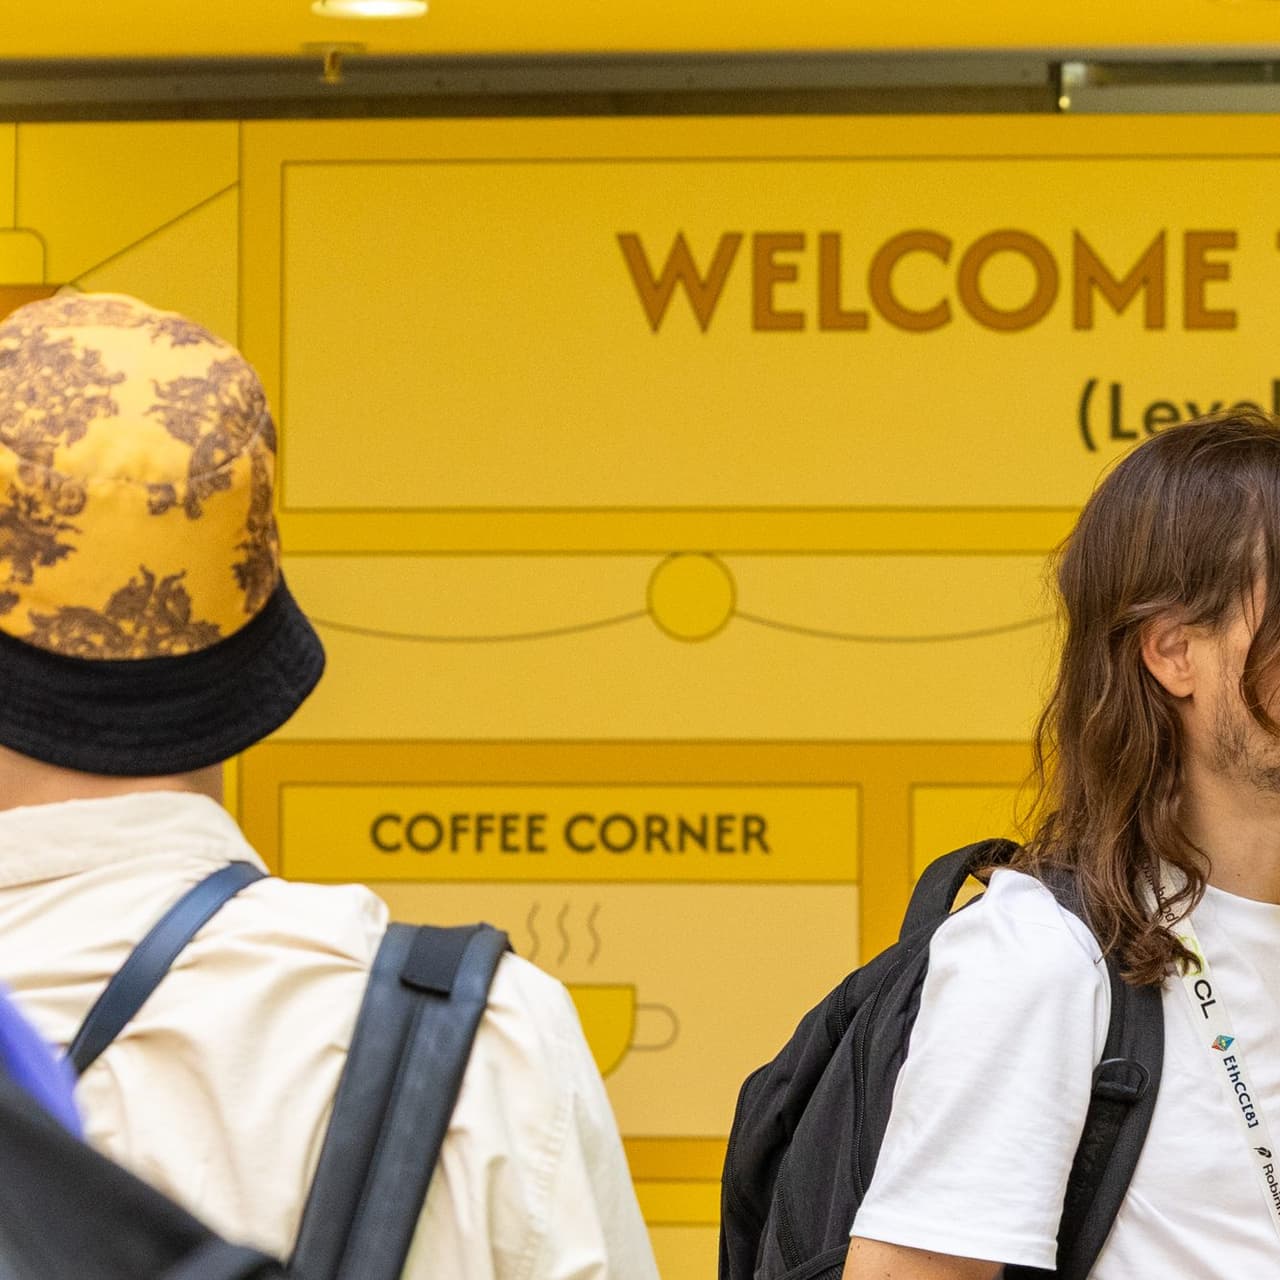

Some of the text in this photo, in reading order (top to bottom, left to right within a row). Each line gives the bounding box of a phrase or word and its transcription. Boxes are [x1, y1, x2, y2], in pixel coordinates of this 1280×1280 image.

[616, 228, 1239, 334] WELCOME
[369, 813, 771, 854] COFFEE CORNER
[1194, 979, 1217, 1019] CL
[1223, 1055, 1259, 1129] EthCC[8]
